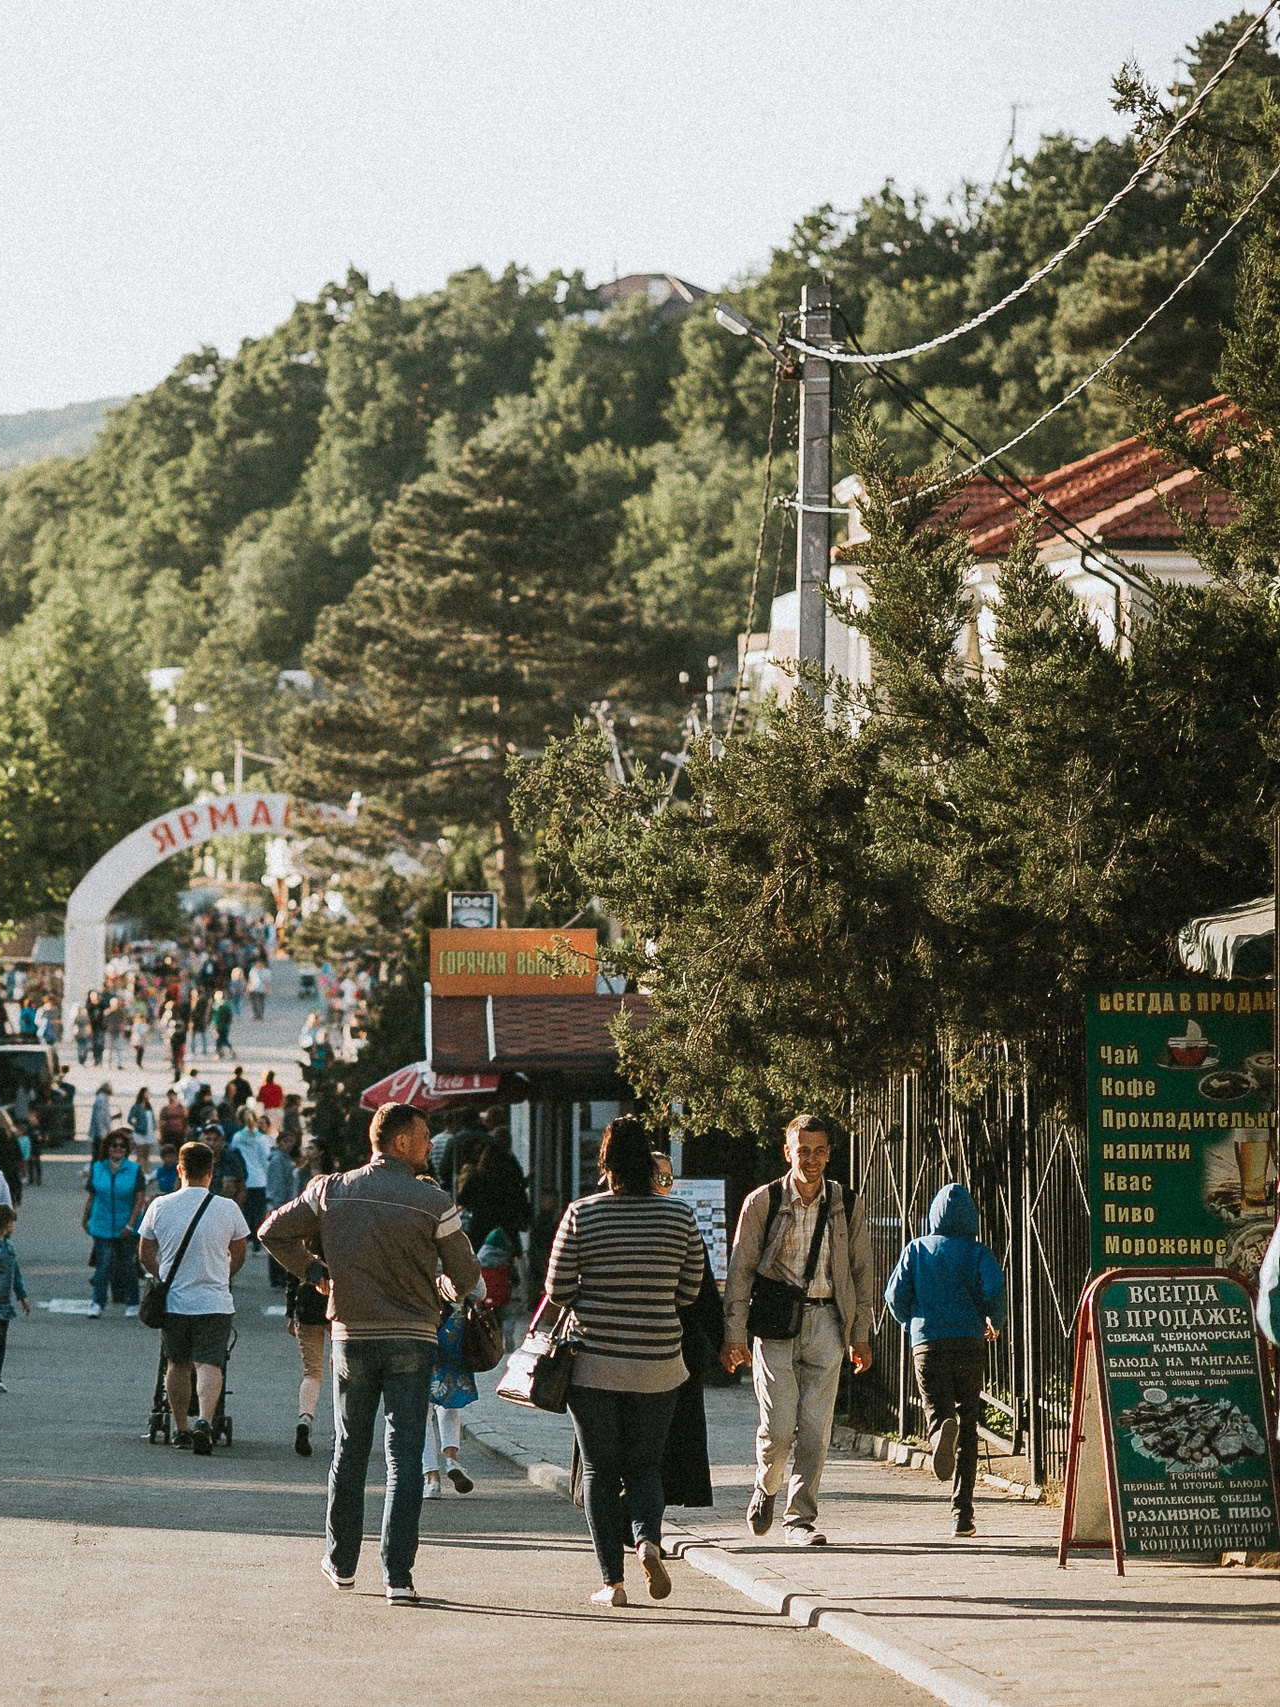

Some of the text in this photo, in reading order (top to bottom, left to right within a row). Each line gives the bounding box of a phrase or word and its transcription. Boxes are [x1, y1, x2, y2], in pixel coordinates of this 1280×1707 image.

[151, 800, 337, 853] ЯРМА
[453, 897, 491, 907] КОФЕ
[438, 951, 507, 975] ГОРЯЧАЯ
[1099, 992, 1175, 1014] ВСЕГДА
[1180, 993, 1191, 1011] В
[1100, 1045, 1139, 1064] Чай
[1102, 1077, 1156, 1098] Кофе
[1103, 1144, 1190, 1159] напитки
[1104, 1172, 1152, 1191] Квас
[1104, 1204, 1155, 1222] Пиво
[1105, 1235, 1227, 1256] Мороженое
[1128, 1285, 1219, 1305] ВСЕГДА
[1105, 1308, 1248, 1330] В ПРОДАЖЕ:
[1107, 1331, 1251, 1342] СВЕЖАЯ ЧЕРНОМОРСКАЯ
[1153, 1343, 1208, 1352] КАМБАЛА
[1109, 1355, 1254, 1368] БЛЮДА НА МАНГАЛЕ:
[1109, 1369, 1146, 1378] шашлык
[1205, 1378, 1229, 1386] гриль
[1172, 1472, 1217, 1481] ГОРЯЧИЕ
[1123, 1483, 1165, 1491] ПЕРВЫЕ
[1183, 1481, 1224, 1490] ВТОРЫЕ
[1230, 1480, 1268, 1488] БЛЮДА
[1133, 1494, 1261, 1506] КОМПЛЕКСНЫЕ ОБЕДЫ
[1127, 1507, 1271, 1522] РАЗЛИВНОЕ ПИВО
[1129, 1523, 1273, 1538] В ЗАЛАХ РАБОТАЮТ
[1140, 1537, 1267, 1552] КОНДИЦИОНЕРЫ
